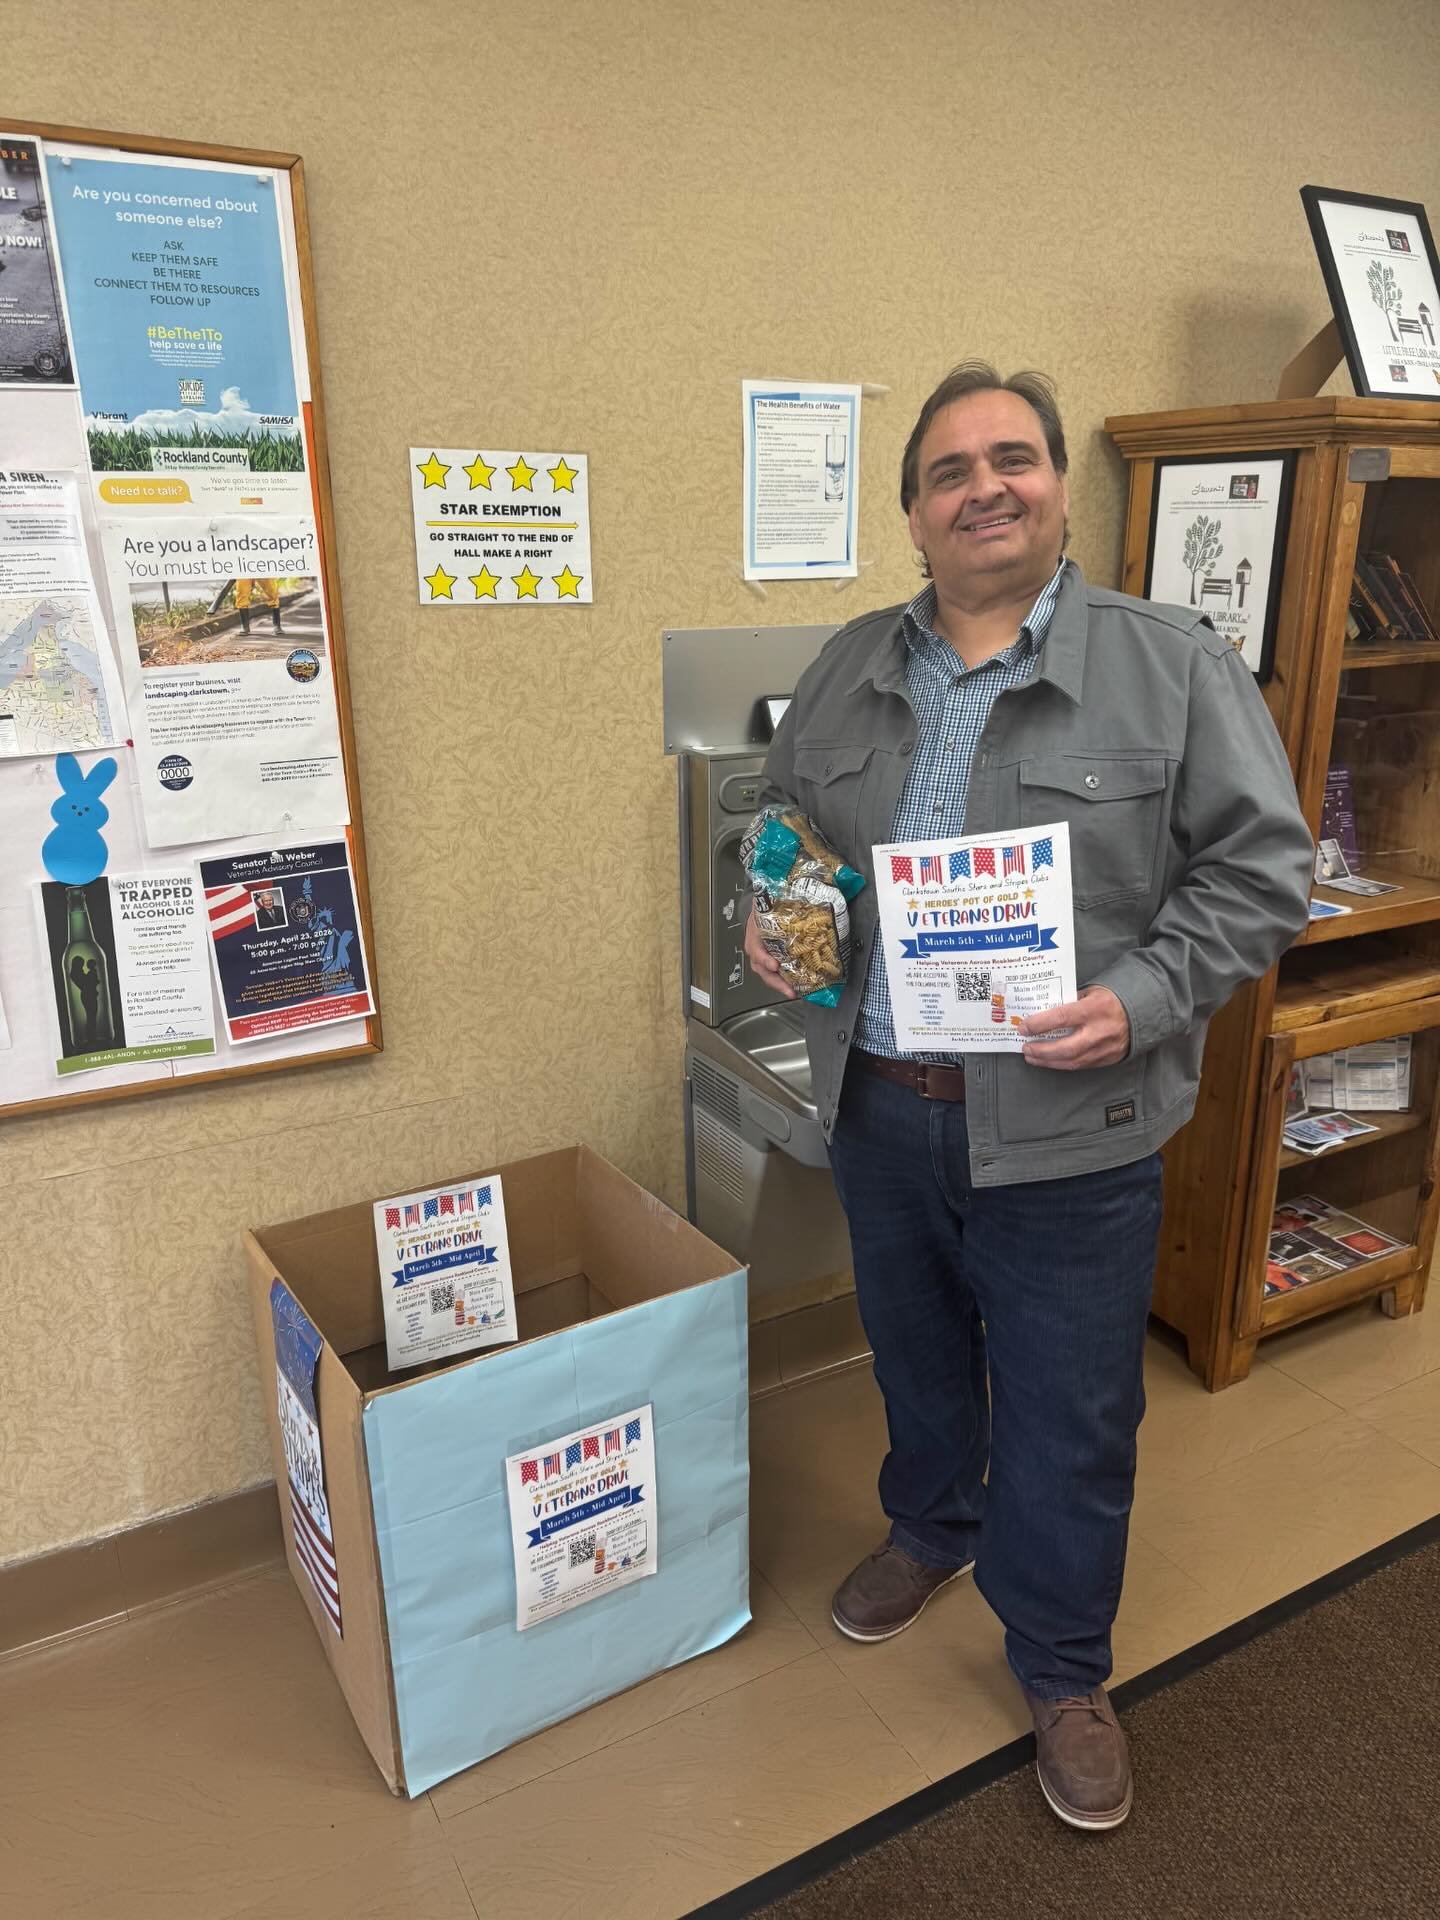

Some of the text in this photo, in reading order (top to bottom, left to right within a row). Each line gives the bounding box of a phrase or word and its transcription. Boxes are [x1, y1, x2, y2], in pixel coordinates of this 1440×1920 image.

[73, 186, 258, 213] Are you concerned about
[116, 212, 222, 229] someone else?
[6, 236, 42, 248] NOW!
[164, 240, 184, 250] ASK
[131, 252, 218, 266] KEEP THEM SAFE
[153, 268, 201, 279] BE THERE
[94, 278, 260, 296] CONNECT THEM TO RESOURCES
[150, 295, 211, 307] FOLLOW UP
[149, 340, 171, 350] help
[174, 342, 196, 350] save
[208, 341, 222, 351] life
[179, 382, 204, 391] SUICIDE
[259, 416, 293, 425] SAMHSA
[163, 451, 247, 466] Rockland County
[10, 472, 58, 483] SIREN...
[111, 486, 184, 496] Need to talk?
[440, 503, 561, 517] STAR EXEMPTION
[430, 533, 444, 541] GO
[447, 533, 499, 542] STRAIGHT
[502, 534, 515, 542] TO
[517, 534, 537, 542] THE
[539, 534, 559, 542] END
[124, 534, 313, 557] Are you a landscaper?
[454, 549, 480, 558] HALL
[483, 549, 512, 557] MAKE
[524, 550, 553, 558] RIGHT
[125, 556, 310, 577] You must be licensed.
[153, 682, 178, 690] register
[161, 767, 189, 779] 0000
[232, 858, 268, 870] Senator
[285, 852, 316, 862] Weber
[227, 858, 323, 879] Veterans Advisory Council
[119, 877, 192, 889] NOT EVERYONE
[120, 887, 192, 902] TRAPPED
[925, 893, 1018, 908] HEROES' POT OF GOLD
[133, 901, 171, 909] ALCOHOL
[122, 907, 194, 920] ALCOHOLIC
[907, 902, 1038, 928] VETERANS DRIVE
[242, 940, 279, 951] Thursday,
[281, 935, 299, 945] April
[314, 929, 333, 938] 2026
[924, 930, 1032, 946] March 5th Mid April
[270, 948, 287, 957] p.m.
[311, 939, 327, 948] p.m.
[1022, 954, 1045, 962] County
[397, 1230, 482, 1261] VETERANS DRIVE
[409, 1262, 430, 1273] March
[432, 1259, 442, 1267] 5th
[464, 1250, 480, 1259] April
[575, 1476, 588, 1485] POT
[590, 1472, 598, 1480] OF
[601, 1465, 616, 1475] GOLD
[533, 1470, 629, 1518] VETERANS DRIVE
[546, 1491, 626, 1530] March 5th Mid April
